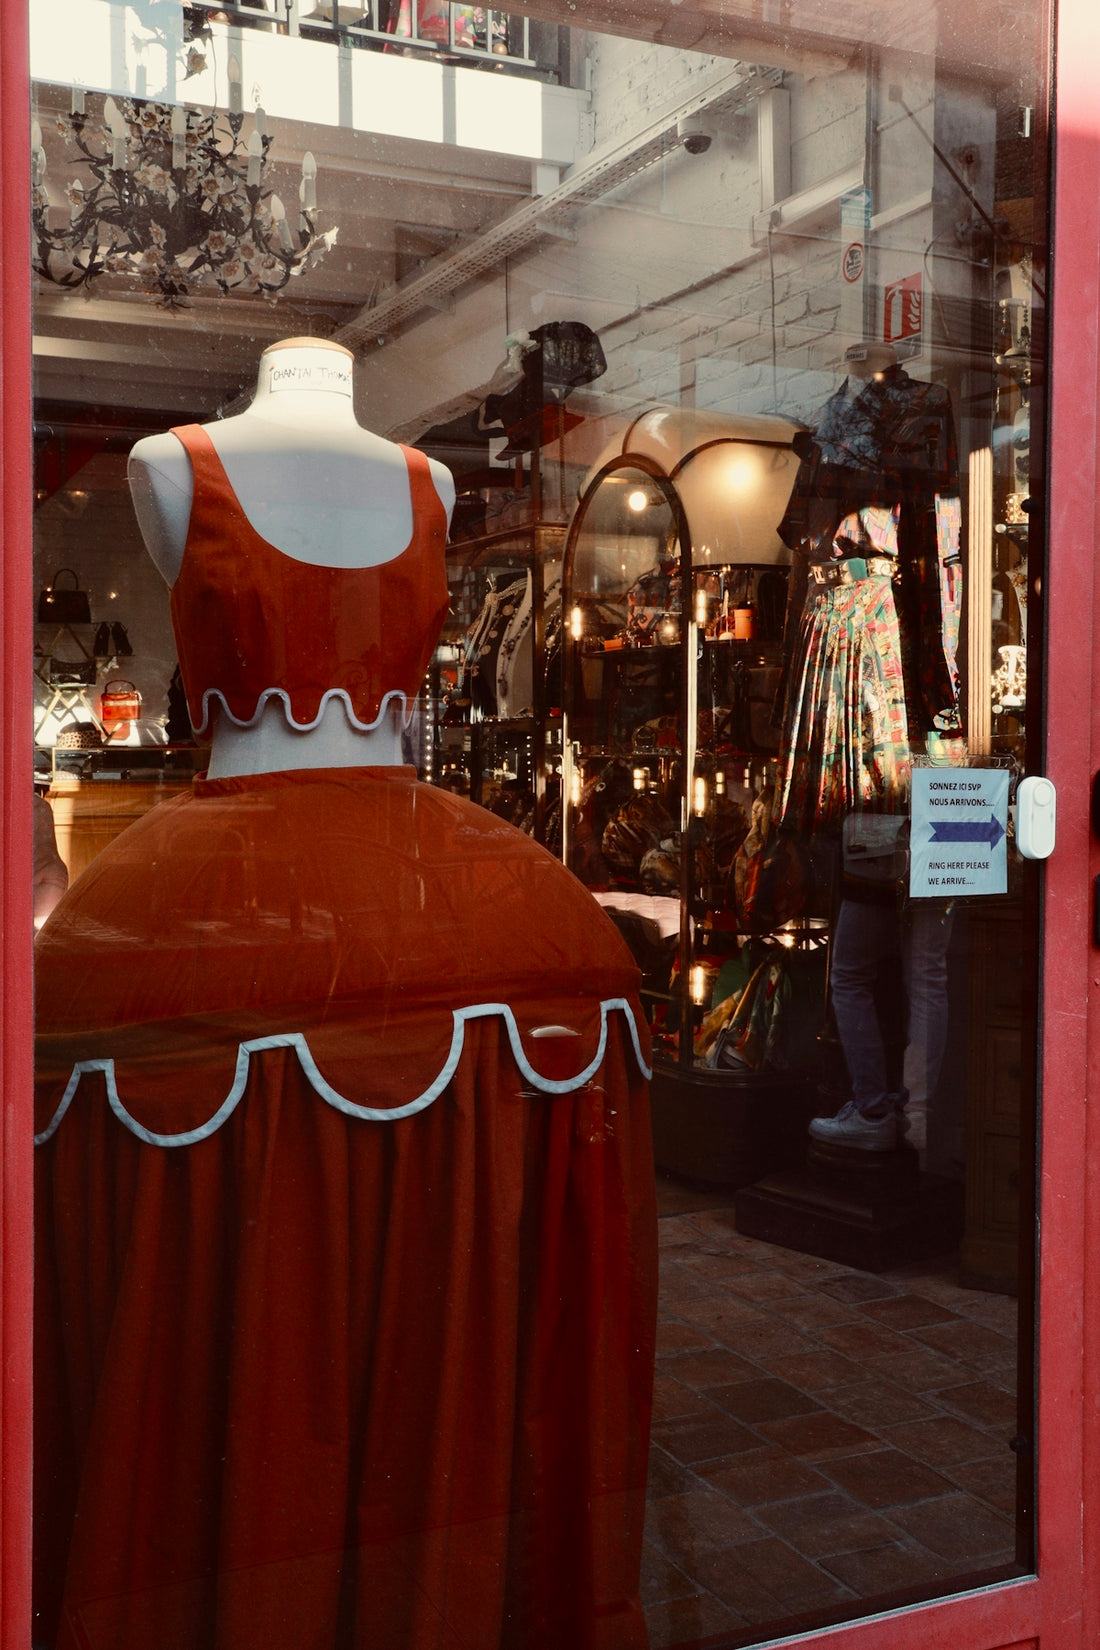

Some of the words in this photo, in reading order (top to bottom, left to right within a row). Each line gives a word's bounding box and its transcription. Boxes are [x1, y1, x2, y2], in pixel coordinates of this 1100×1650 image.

[968, 783, 981, 791] SVP
[929, 798, 948, 806] NOUS
[928, 877, 939, 885] WE
